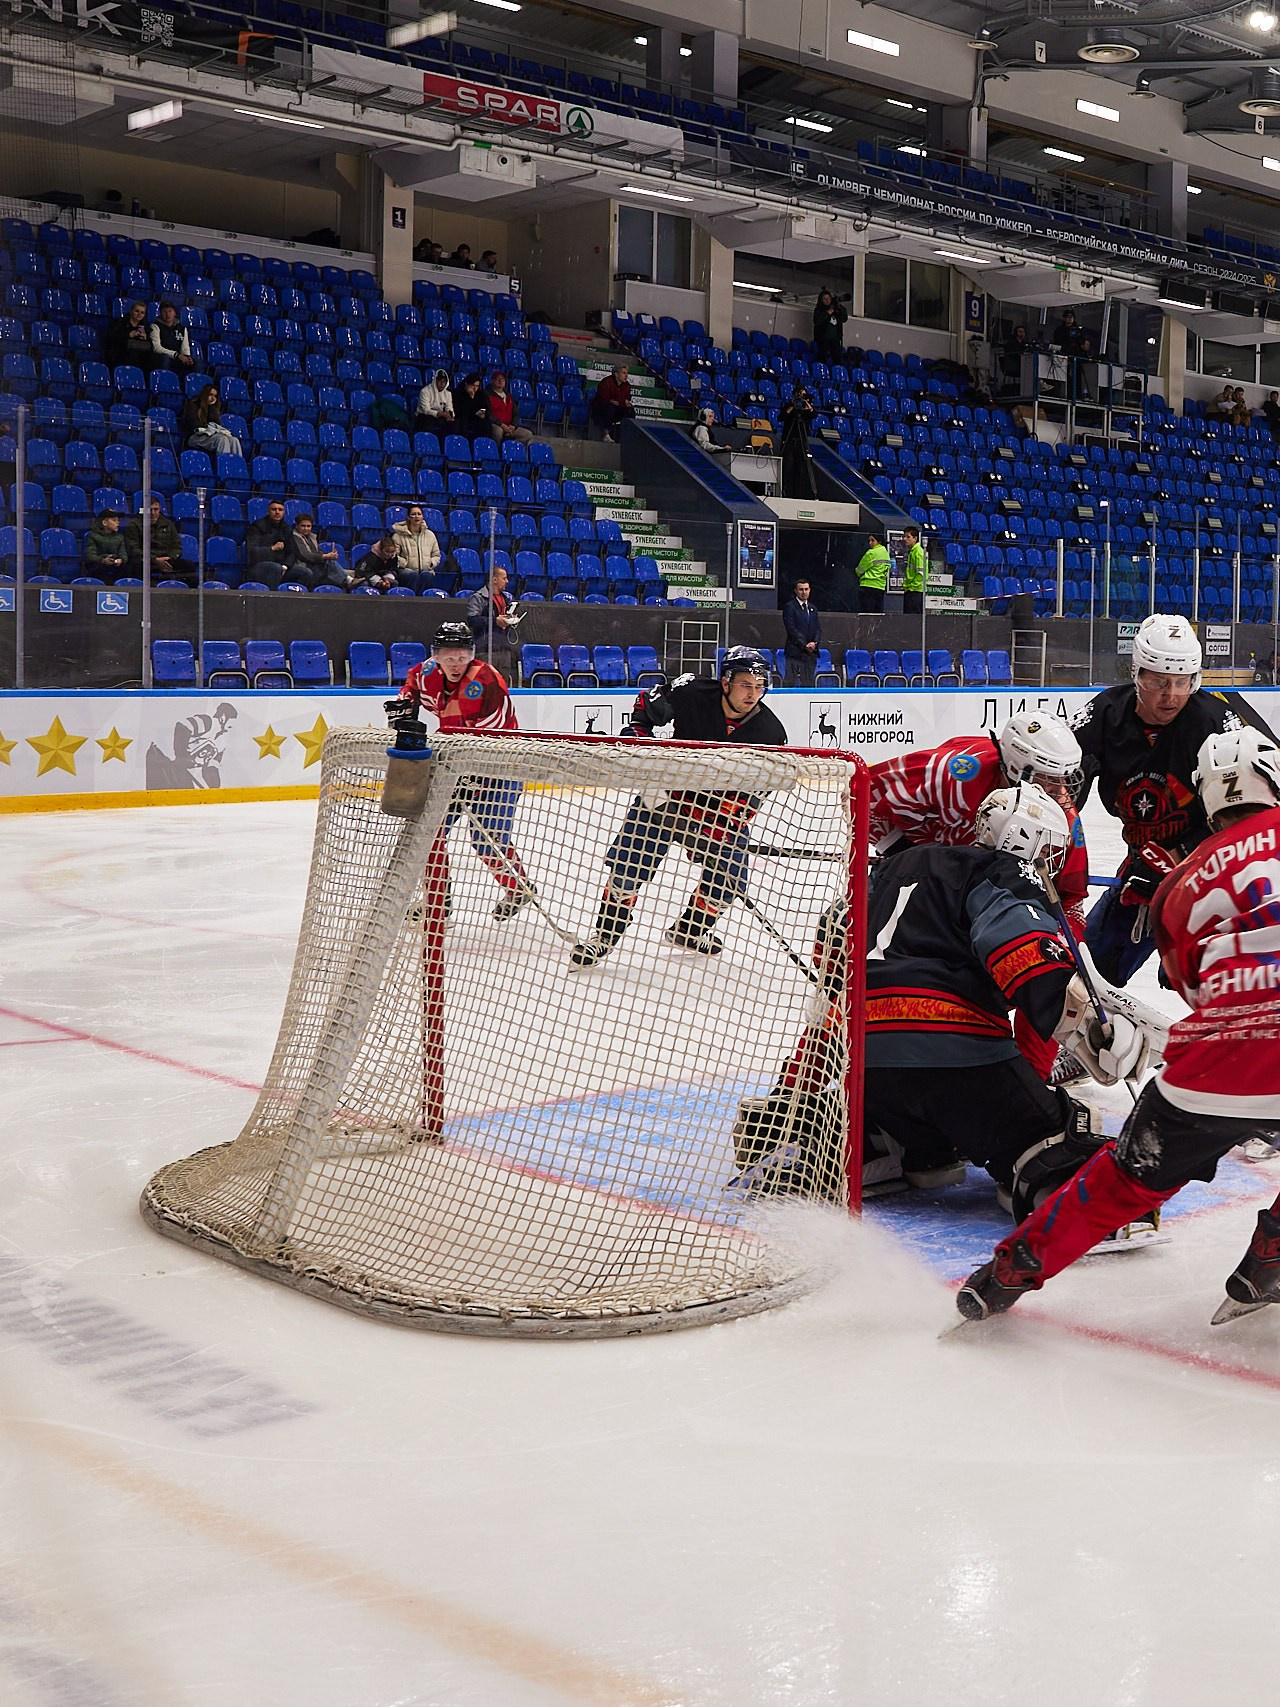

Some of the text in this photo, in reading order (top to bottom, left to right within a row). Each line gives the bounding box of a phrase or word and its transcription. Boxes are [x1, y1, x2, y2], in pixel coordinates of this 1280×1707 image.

[1037, 46, 1044, 57] 7
[457, 86, 558, 126] SPAR
[1257, 120, 1263, 130] 6
[394, 210, 403, 223] 1
[873, 186, 936, 212] ЧЕМПИОНАТ
[937, 203, 977, 222] РОССИИ
[979, 212, 993, 225] ПО
[995, 216, 1033, 234] ХОККЕЮ
[1046, 227, 1118, 251] ВСЕРОССИЙСКАЯ
[510, 278, 520, 292] 5
[971, 299, 980, 318] 9
[634, 408, 662, 417] SYNERGETIC
[571, 471, 609, 480] ДЛЯ ЧИСТОТЫ
[589, 485, 621, 495] SYNERGETIC
[605, 498, 630, 506] КРАСОТЫ
[611, 510, 643, 521] SYNERGETIC
[625, 524, 653, 532] ЗДОРОВЬЯ
[635, 535, 667, 545] SYNERGETIC
[660, 562, 693, 571] SYNERGETIC
[678, 575, 703, 583] КРАСОТЫ
[686, 587, 717, 598] SYNERGETIC
[1119, 625, 1140, 634] PAR
[848, 709, 904, 726] НИЖНИЙ
[848, 731, 914, 745] НОВГОРОД
[1222, 776, 1243, 798] Z
[1251, 1028, 1278, 1040] МЧС
